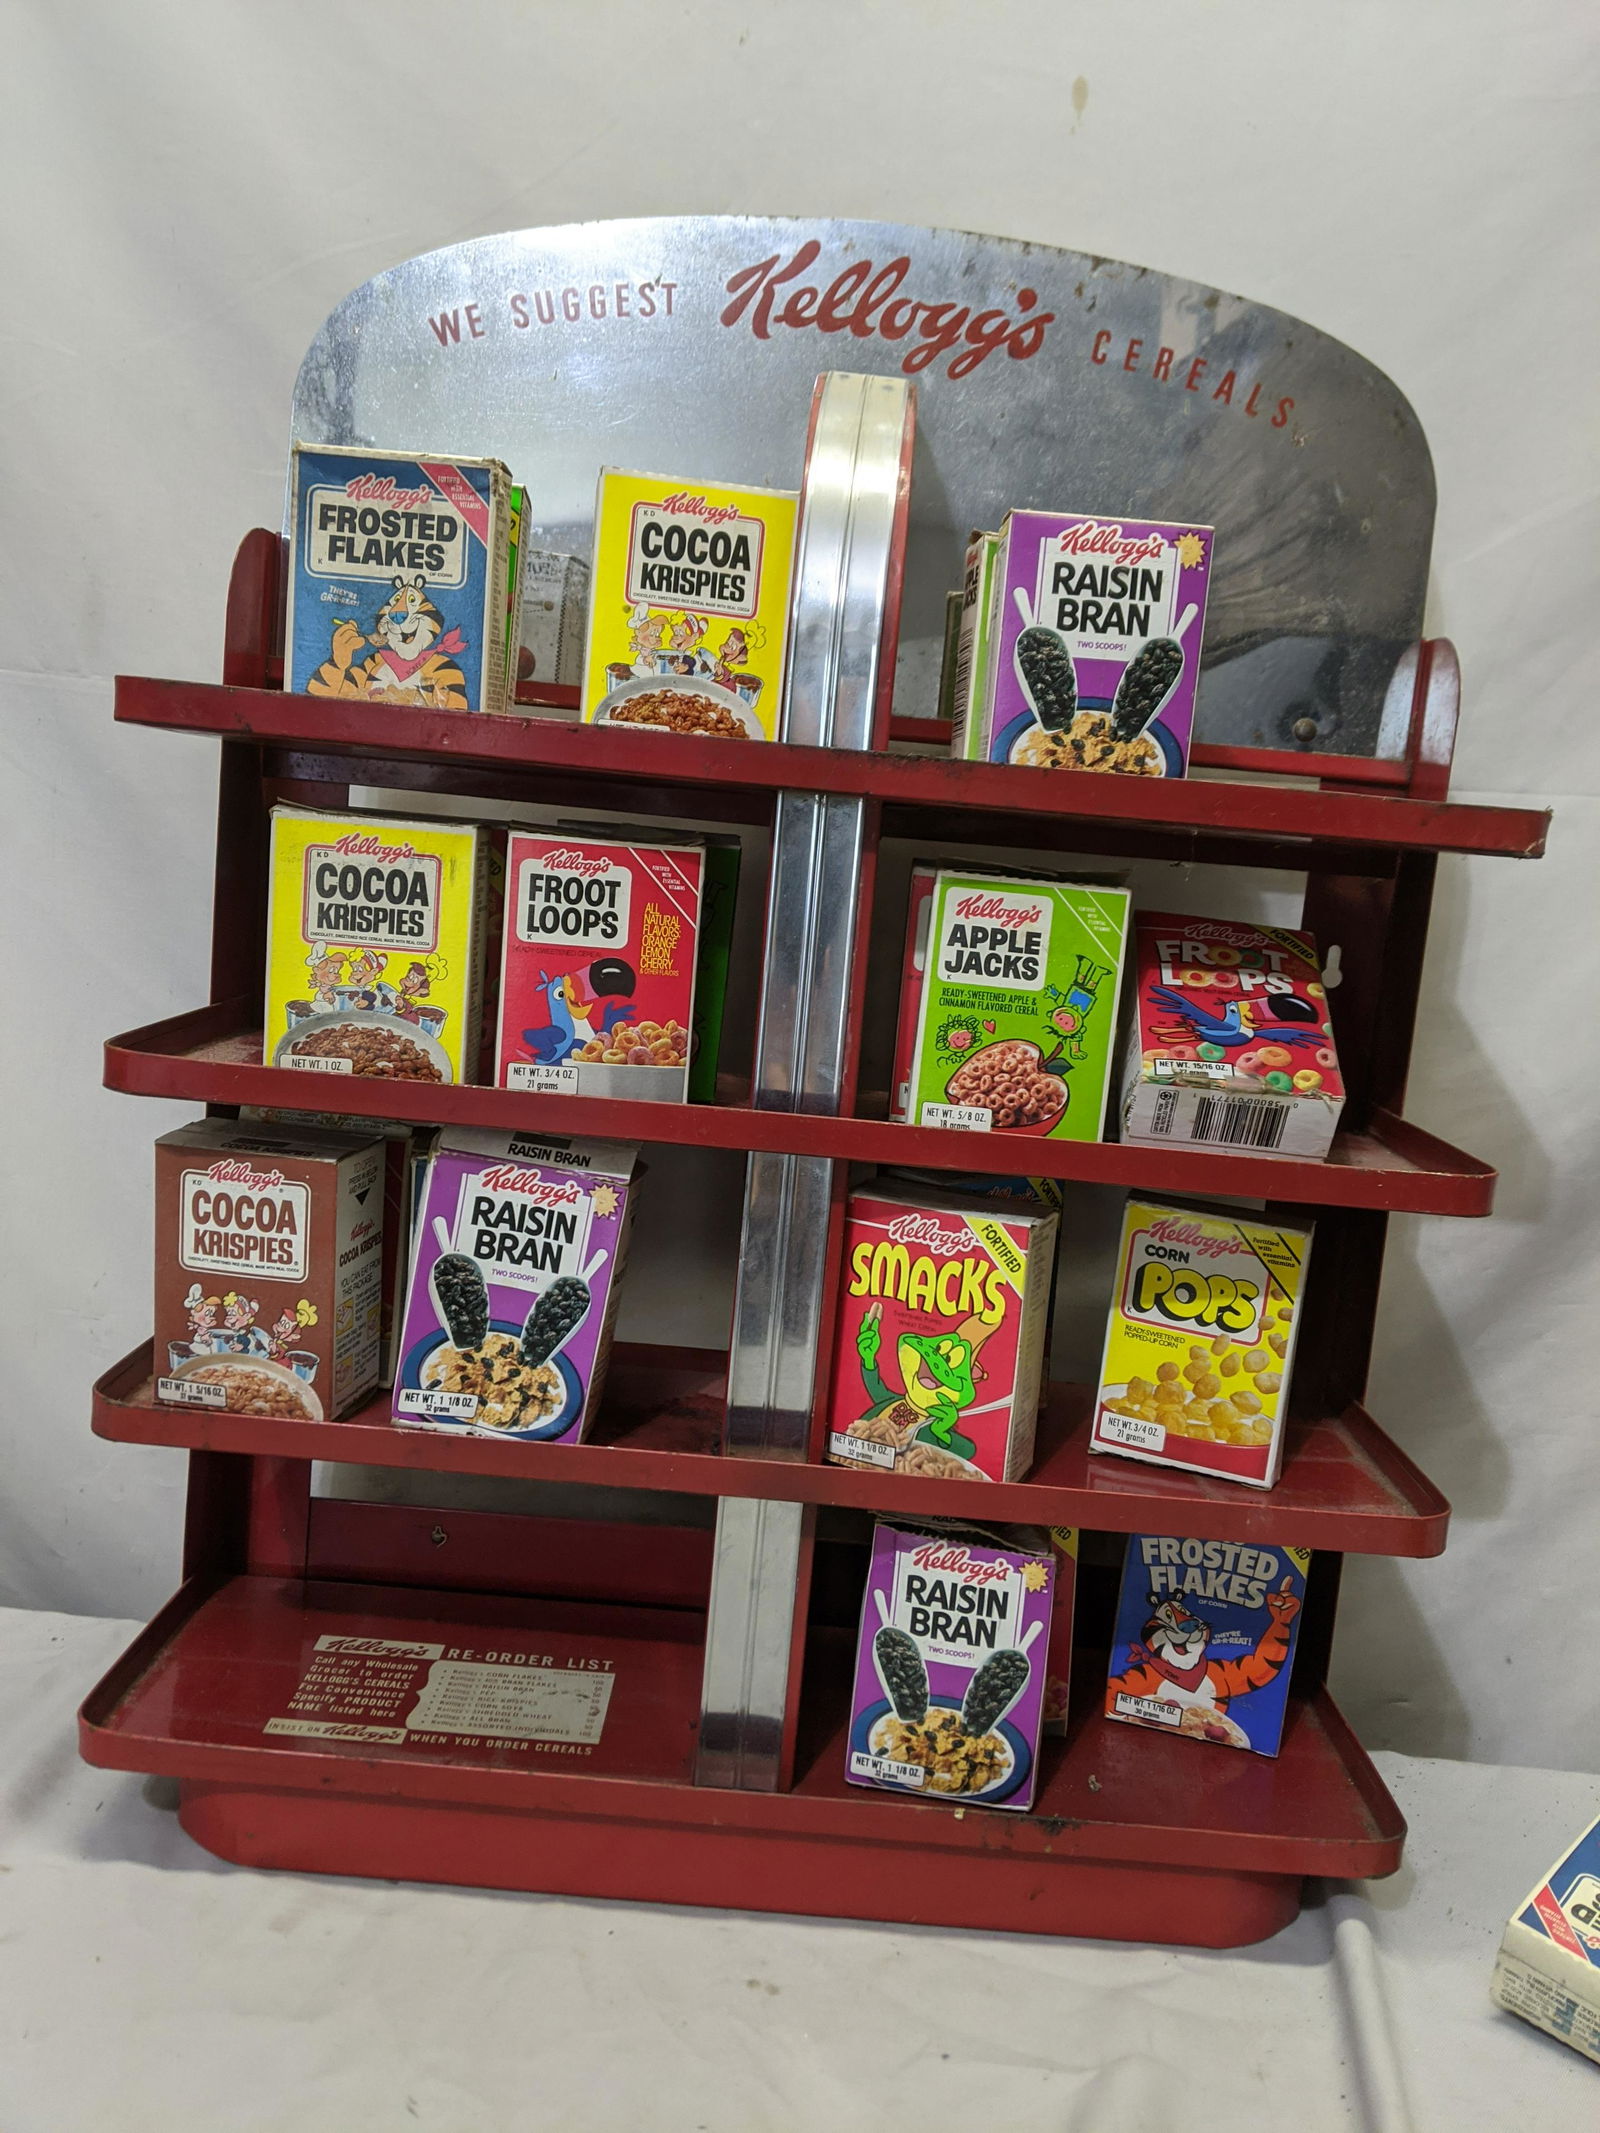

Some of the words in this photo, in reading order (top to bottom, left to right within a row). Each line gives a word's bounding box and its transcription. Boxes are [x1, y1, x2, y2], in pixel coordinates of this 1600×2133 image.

[428, 304, 485, 347] WE
[510, 283, 678, 328] SUGGEST
[720, 239, 1055, 380] Kellogg's
[1091, 329, 1295, 427] CEREALS
[346, 473, 432, 509] Kellogg's
[663, 492, 739, 525] Kellogg's
[319, 504, 457, 542] FROSTED
[328, 535, 444, 570] FLAKES
[641, 522, 751, 571] COCOA
[1061, 523, 1163, 565] Kellogg's
[640, 562, 746, 602] KRISPIES
[1052, 561, 1163, 602] RAISIN
[1056, 598, 1150, 637] BRAN
[1077, 640, 1094, 649] TWO
[1095, 642, 1127, 652] SCOOPS!
[335, 833, 415, 863] Kellogg's
[543, 850, 611, 878] Kellogg's
[315, 863, 429, 906] COCOA
[529, 873, 621, 908] FROOT
[317, 903, 424, 937] KRISPIES
[644, 914, 680, 928] NATURAL
[645, 903, 659, 915] ALL
[955, 895, 1042, 928] Kellogg's
[527, 904, 619, 939] LOOPS
[642, 925, 682, 938] FLAVORS:
[642, 935, 677, 949] ORANGE
[947, 924, 1041, 955] APPLE
[1185, 924, 1268, 946] Kellogg's
[1270, 929, 1314, 960] FORTIFIED
[640, 957, 673, 969] CHERRY
[641, 947, 670, 959] LEMON
[1155, 940, 1289, 971] FROOT
[944, 950, 1039, 981] JACKS
[1160, 963, 1294, 994] LOOPS
[939, 998, 976, 1009] CINNAMON
[977, 1001, 1013, 1014] FLAVORED
[1014, 1005, 1039, 1015] CEREAL
[942, 988, 1006, 1002] READY-SWEETENED
[1009, 993, 1030, 1004] APPLE
[1032, 997, 1036, 1005] &
[292, 1058, 306, 1069] NET
[309, 1059, 323, 1070] WT.
[325, 1061, 329, 1070] 1
[330, 1061, 343, 1071] OZ.
[514, 1067, 529, 1076] NET
[530, 1068, 543, 1078] WT.
[545, 1068, 561, 1079] 3/4
[563, 1069, 575, 1079] OZ.
[527, 1080, 535, 1089] 21
[537, 1081, 558, 1091] grams
[927, 1107, 940, 1117] NET
[942, 1109, 955, 1120] WT.
[957, 1110, 972, 1120] 5/8
[974, 1112, 986, 1122] OZ.
[940, 1120, 947, 1128] 18
[949, 1121, 970, 1130] grams
[508, 1143, 552, 1160] RAISIN
[554, 1151, 591, 1167] BRAN
[208, 1160, 283, 1191] Kellogg's
[481, 1166, 581, 1206] Kellogg's
[192, 1190, 297, 1235] COCOA
[471, 1196, 577, 1244] RAISIN
[891, 1216, 974, 1251] Kellogg's
[1151, 1220, 1242, 1258] Kellogg's
[1253, 1237, 1280, 1247] Fortified
[193, 1229, 294, 1265] KRISPIES
[474, 1230, 563, 1273] BRAN
[981, 1224, 1022, 1274] FORTIFIED
[1144, 1244, 1190, 1264] CORN
[1262, 1252, 1292, 1262] essential
[1268, 1259, 1296, 1268] vitamins
[492, 1269, 508, 1277] TWO
[509, 1271, 538, 1283] SCOOPS!
[850, 1242, 1008, 1324] SMACKS
[1132, 1261, 1259, 1332] POPS
[1124, 1332, 1158, 1346] POPPED-UP
[1159, 1339, 1178, 1349] CORN
[1125, 1324, 1185, 1344] READY-SWEETENED
[160, 1380, 172, 1391] NET
[174, 1382, 187, 1393] WT.
[189, 1384, 193, 1393] 1
[196, 1385, 211, 1396] 5/16
[212, 1388, 224, 1397] OZ.
[404, 1392, 420, 1403] NET
[423, 1393, 437, 1405] WT.
[440, 1395, 444, 1405] 1
[448, 1396, 460, 1407] 1/8
[462, 1397, 474, 1408] OZ.
[1108, 1416, 1120, 1428] NET
[1121, 1419, 1133, 1432] WT.
[1134, 1422, 1146, 1434] 3/4
[1148, 1426, 1159, 1438] OZ.
[1117, 1428, 1123, 1438] 21
[1125, 1432, 1146, 1444] grams
[835, 1435, 846, 1444] NET
[848, 1438, 859, 1448] WT.
[867, 1444, 876, 1452] 1/8
[878, 1446, 888, 1455] OZ.
[913, 1545, 1010, 1585] Kellogg's
[1141, 1538, 1279, 1581] FROSTED
[905, 1575, 1009, 1620] RAISIN
[1149, 1566, 1267, 1609] FLAKES
[909, 1608, 997, 1648] BRAN
[325, 1639, 429, 1657] Kellogg's
[447, 1649, 554, 1666] RE-ORDER
[567, 1657, 615, 1671] LIST
[928, 1646, 943, 1654] TWO
[944, 1648, 975, 1659] SCOOPS!
[310, 1665, 351, 1675] Grocer
[381, 1672, 414, 1680] order
[315, 1656, 336, 1664] Call
[341, 1658, 360, 1667] any
[366, 1660, 418, 1671] Wholesale
[298, 1682, 322, 1695] For
[326, 1685, 405, 1698] Convenience
[304, 1674, 359, 1685] KELLOGG'S
[364, 1678, 410, 1690] CEREALS
[287, 1701, 321, 1713] NAME
[329, 1706, 364, 1715] listed
[370, 1709, 396, 1718] here
[294, 1692, 336, 1705] Specify
[344, 1697, 401, 1708] PRODUCT
[1120, 1694, 1133, 1704] NET
[1134, 1698, 1145, 1708] WT.
[1147, 1700, 1150, 1709] 1
[1152, 1702, 1165, 1713] 1/16
[1166, 1706, 1177, 1716] OZ.
[269, 1722, 305, 1732] INSIST
[322, 1725, 401, 1741] Kellogg's
[410, 1733, 446, 1744] WHEN
[453, 1735, 480, 1747] YOU
[486, 1738, 528, 1750] ORDER
[535, 1742, 592, 1756] CEREALS
[856, 1756, 869, 1768] NET
[871, 1760, 885, 1770] WT.
[888, 1762, 891, 1772] 1
[896, 1764, 908, 1775] 1/8
[909, 1768, 920, 1778] OZ.
